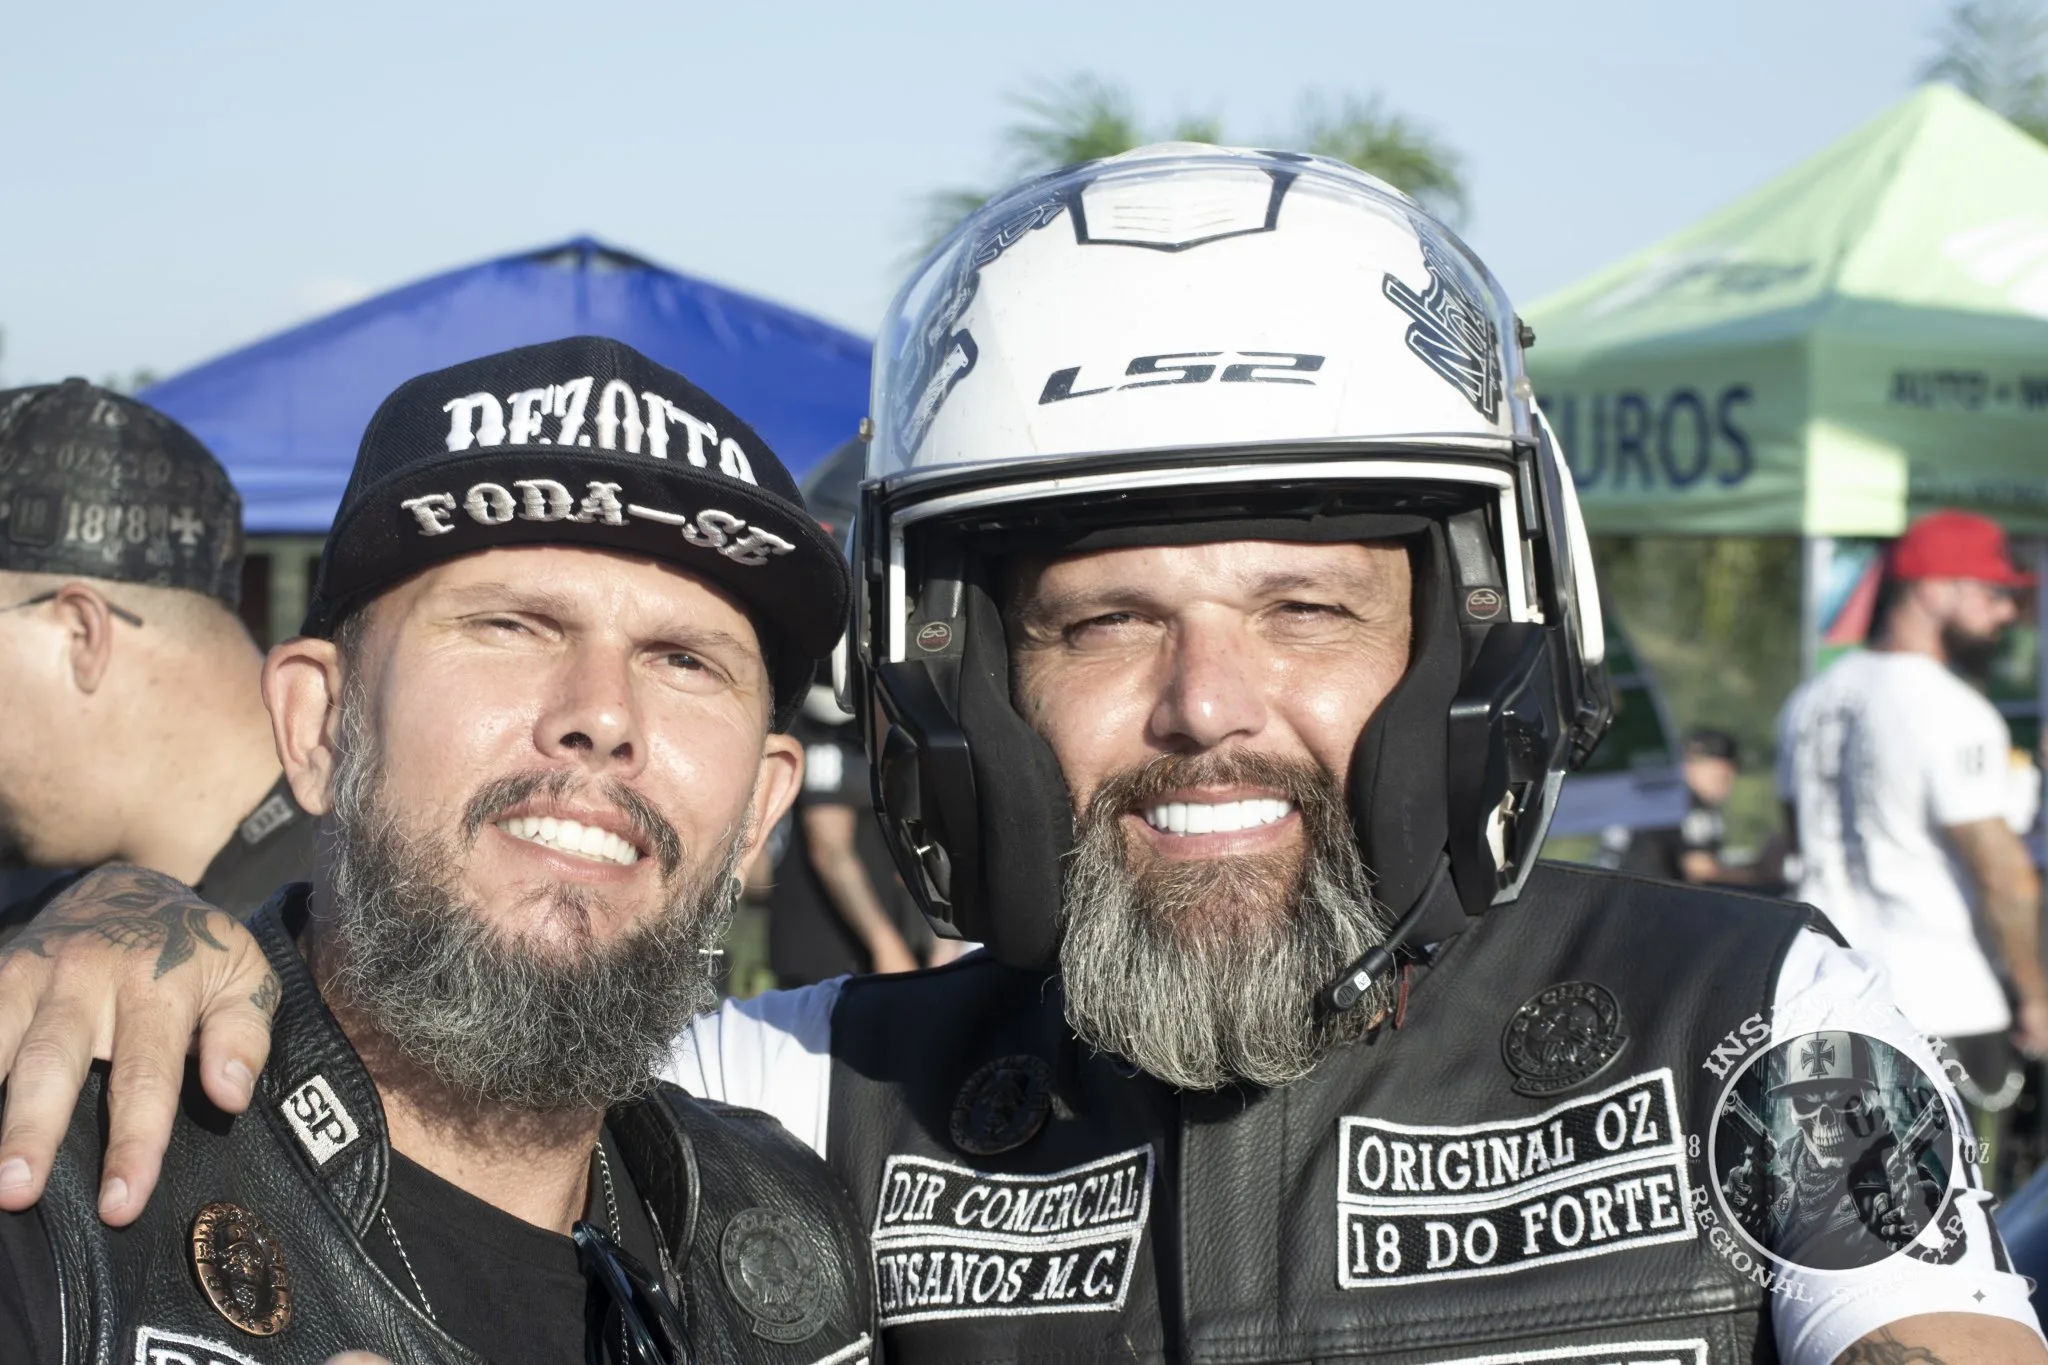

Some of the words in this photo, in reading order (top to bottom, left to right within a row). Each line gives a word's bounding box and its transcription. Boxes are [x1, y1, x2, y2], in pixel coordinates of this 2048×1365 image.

[1038, 351, 1326, 405] LS2
[1539, 384, 1756, 491] UROS
[290, 1085, 347, 1144] SP
[1357, 1119, 1575, 1190] ORIGINAL
[1595, 1090, 1658, 1150] OZ
[884, 1171, 946, 1223] DIR
[951, 1165, 1138, 1233] COMERCIAL
[1352, 1222, 1401, 1273] 18
[1425, 1218, 1498, 1269] DO
[1520, 1173, 1681, 1255] FORTE
[879, 1251, 1032, 1311] INSANOS
